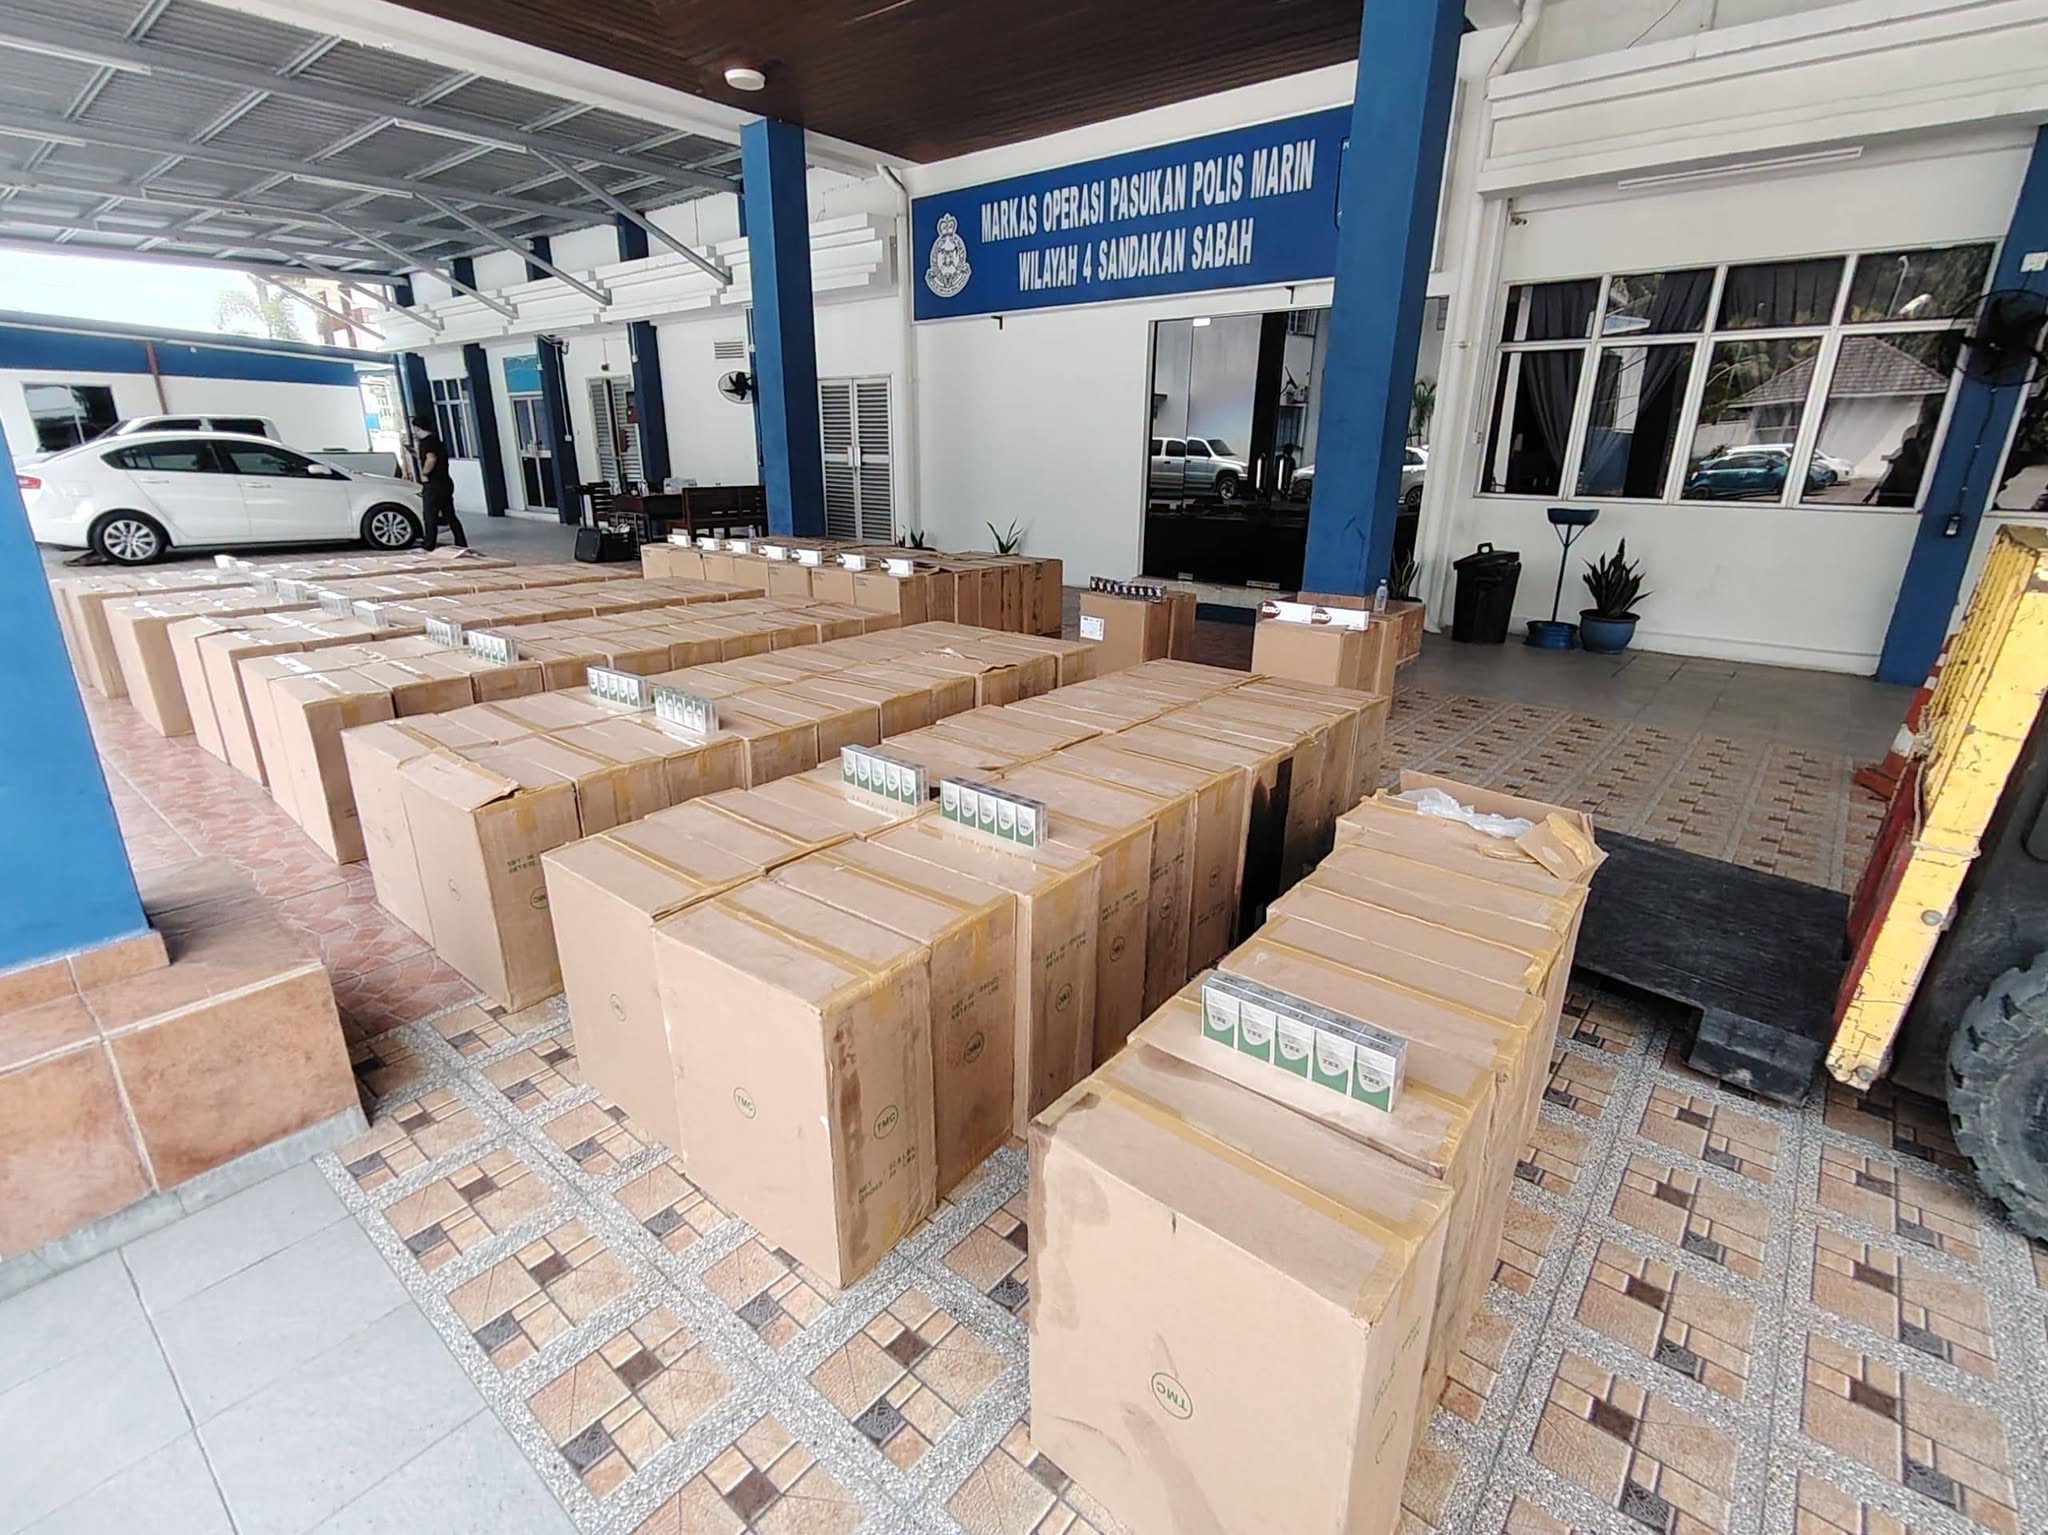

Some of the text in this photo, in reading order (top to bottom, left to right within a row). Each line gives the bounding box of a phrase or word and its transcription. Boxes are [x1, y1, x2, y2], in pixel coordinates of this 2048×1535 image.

[981, 138, 1316, 243] MARKAS OPERASI PASUKAN POLIS MARIN
[1018, 217, 1254, 291] WILAYAH 4 SANDAKAN SABAH
[1156, 1381, 1188, 1413] TMC
